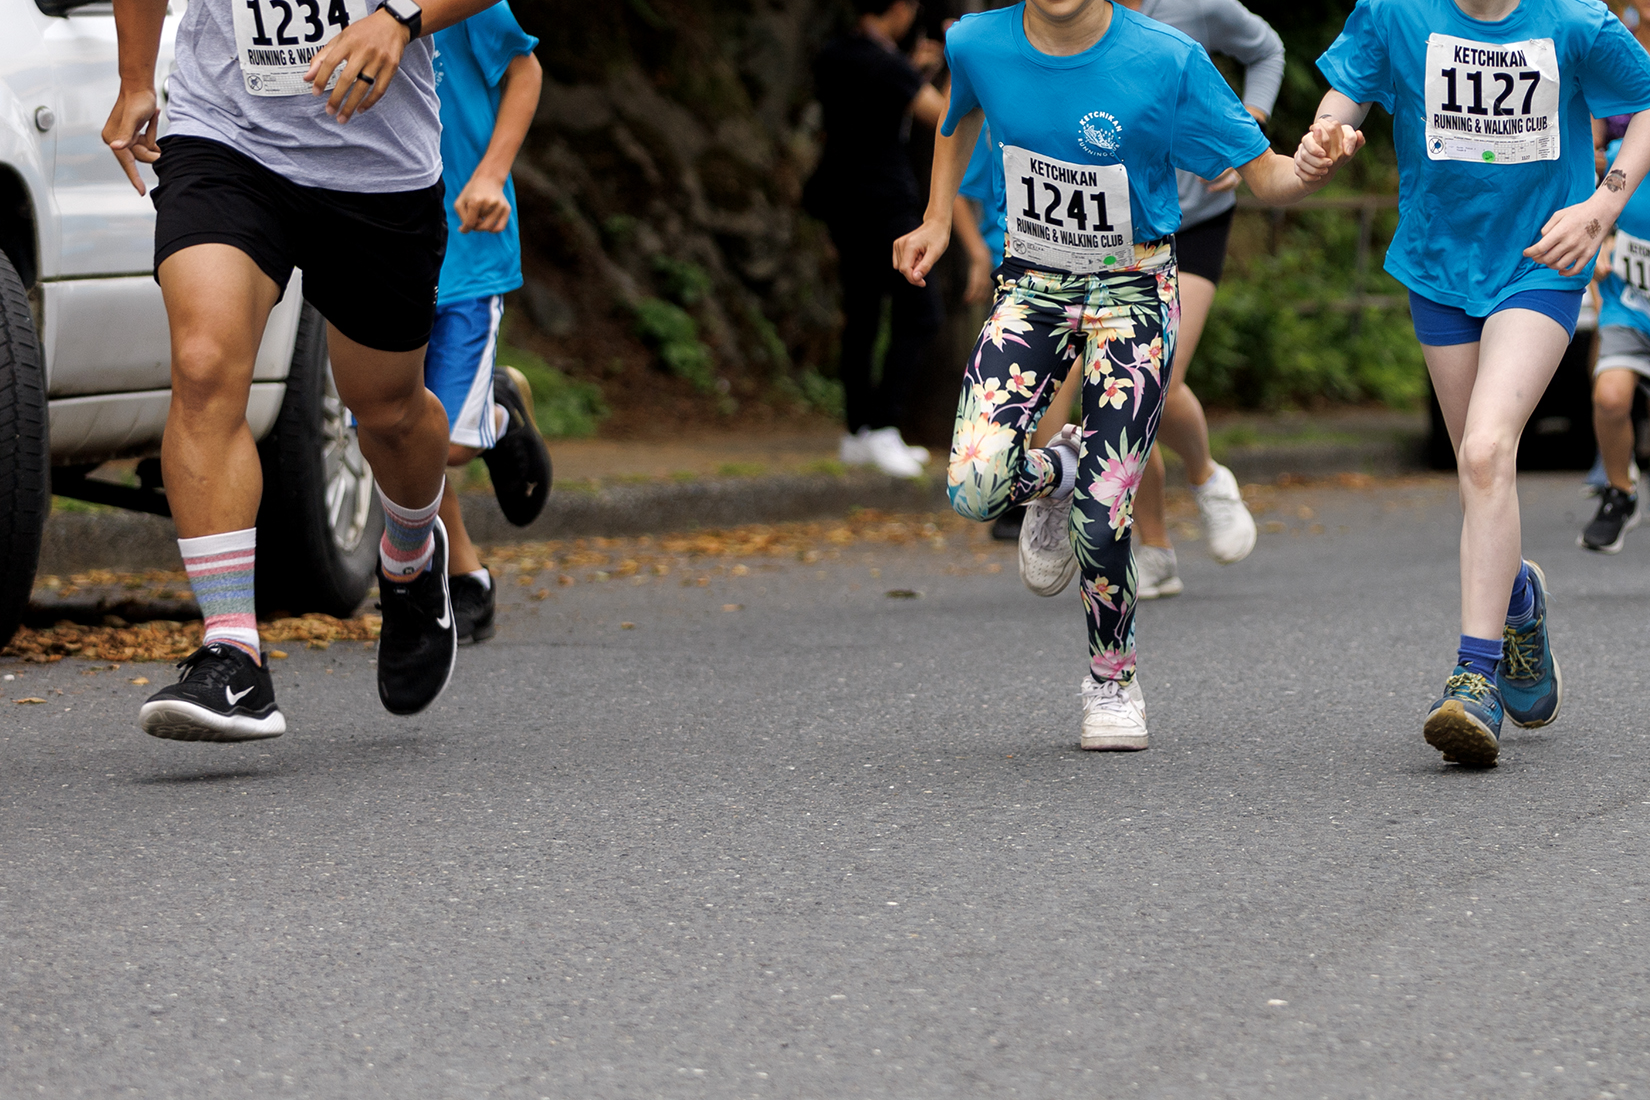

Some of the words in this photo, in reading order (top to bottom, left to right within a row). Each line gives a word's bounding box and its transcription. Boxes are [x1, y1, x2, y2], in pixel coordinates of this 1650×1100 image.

[247, 48, 288, 66] RUNNING
[288, 49, 297, 65] &
[1454, 44, 1528, 68] KETCHIKAN
[1441, 67, 1540, 116] 1127
[1079, 111, 1122, 132] KETCHIKAN
[1434, 113, 1473, 132] RUNNING
[1475, 118, 1482, 133] &
[1484, 118, 1523, 135] WALKING
[1525, 115, 1548, 132] CLUB
[1030, 157, 1097, 187] KETCHIKAN
[1021, 176, 1114, 232] 1241
[1016, 217, 1050, 241] RUNNING
[1052, 229, 1059, 243] &
[1060, 230, 1098, 249] WALKING
[1100, 234, 1124, 249] CLUB
